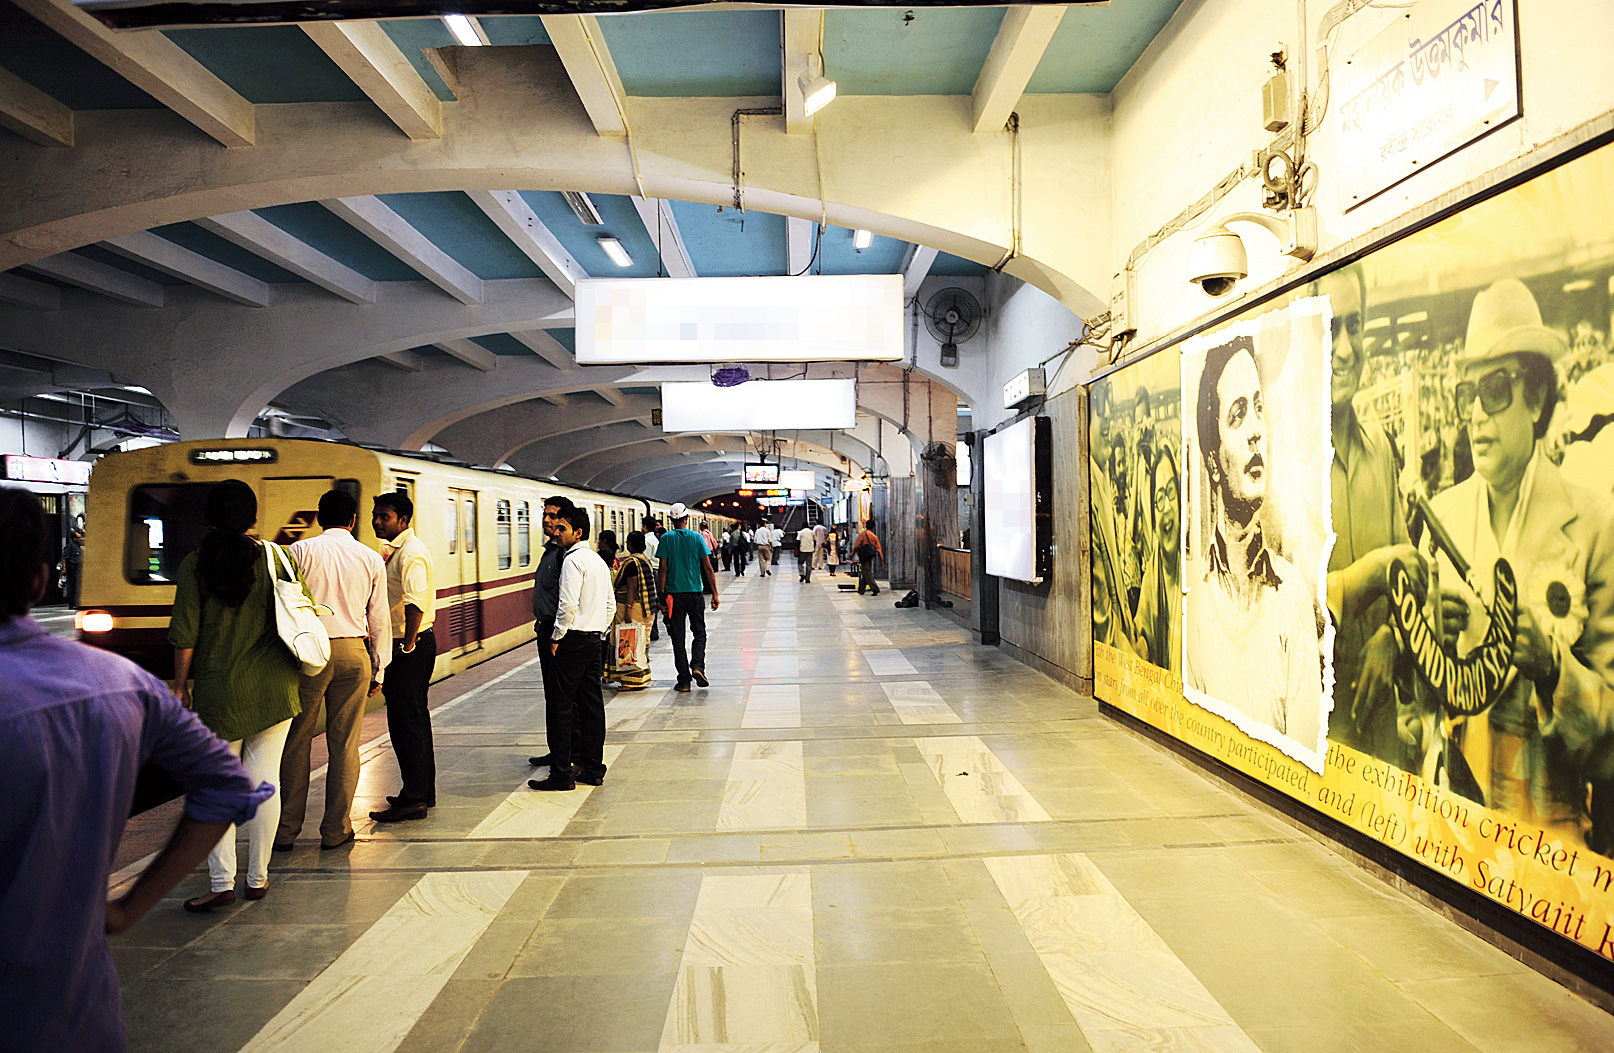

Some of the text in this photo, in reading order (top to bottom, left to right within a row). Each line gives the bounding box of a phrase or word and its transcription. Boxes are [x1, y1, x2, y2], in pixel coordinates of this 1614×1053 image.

[1392, 569, 1445, 688] SOUND
[1446, 657, 1487, 711] RADIO
[1103, 674, 1119, 691] stars
[1118, 679, 1137, 701] from
[1138, 689, 1149, 707] all
[1151, 698, 1169, 717] over
[1171, 704, 1185, 725] the
[1186, 717, 1226, 753] country
[1227, 736, 1311, 799] participated,
[1318, 787, 1356, 817] and
[1360, 801, 1408, 846] (left)
[1415, 835, 1465, 876] with
[1473, 860, 1587, 941] Satyajit
[1105, 647, 1116, 664] the
[1118, 652, 1133, 672] West
[1135, 660, 1162, 686] Bengal
[1165, 672, 1184, 696] Chie
[1328, 744, 1356, 774] the
[1362, 763, 1469, 828] exhibition
[1479, 817, 1580, 877] cricket
